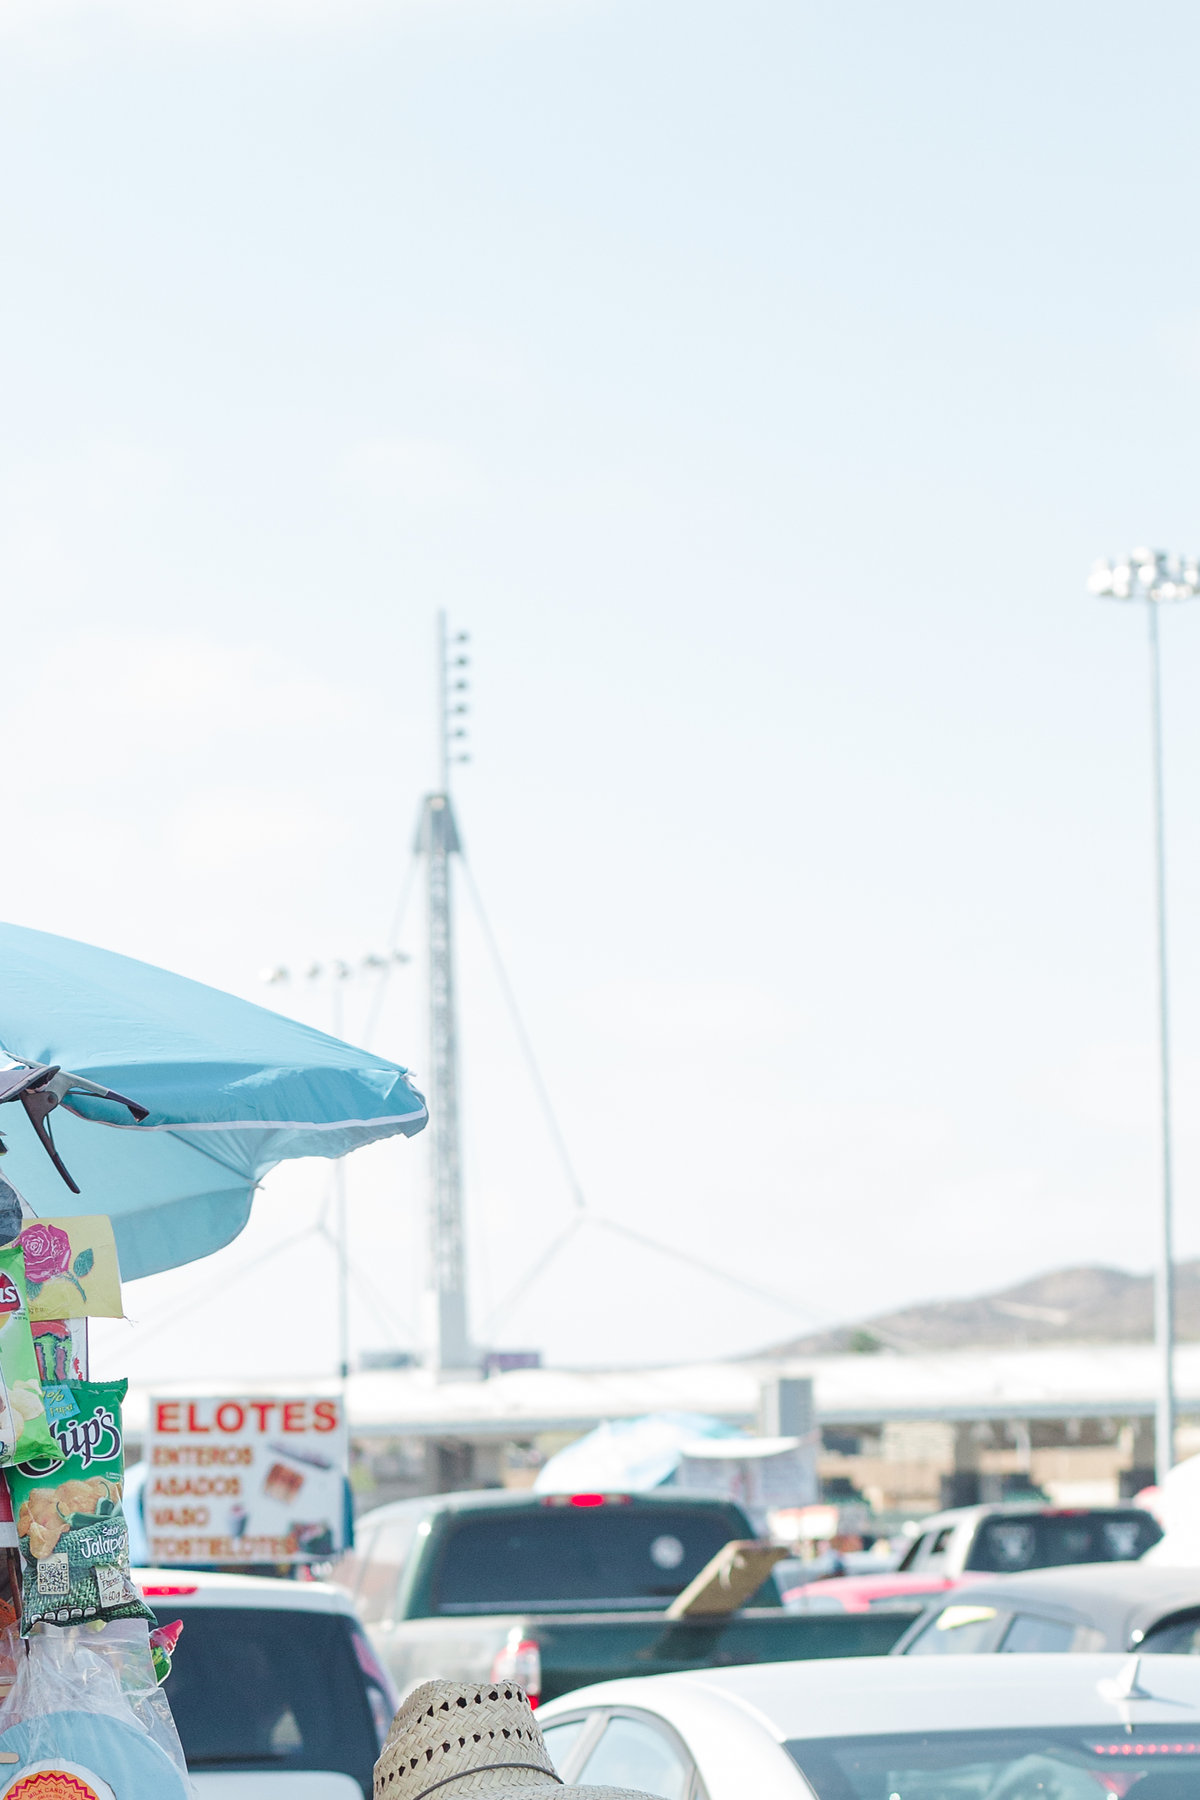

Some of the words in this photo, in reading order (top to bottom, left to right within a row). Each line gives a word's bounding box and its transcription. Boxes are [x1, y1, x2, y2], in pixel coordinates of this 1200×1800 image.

[156, 1402, 339, 1433] ELOTES
[153, 1446, 253, 1467] ENTEROS
[153, 1476, 241, 1497] ASADOS
[153, 1507, 210, 1527] VASO
[102, 1526, 120, 1537] Sabor
[28, 1789, 43, 1799] MILK
[44, 1787, 68, 1795] CANDY
